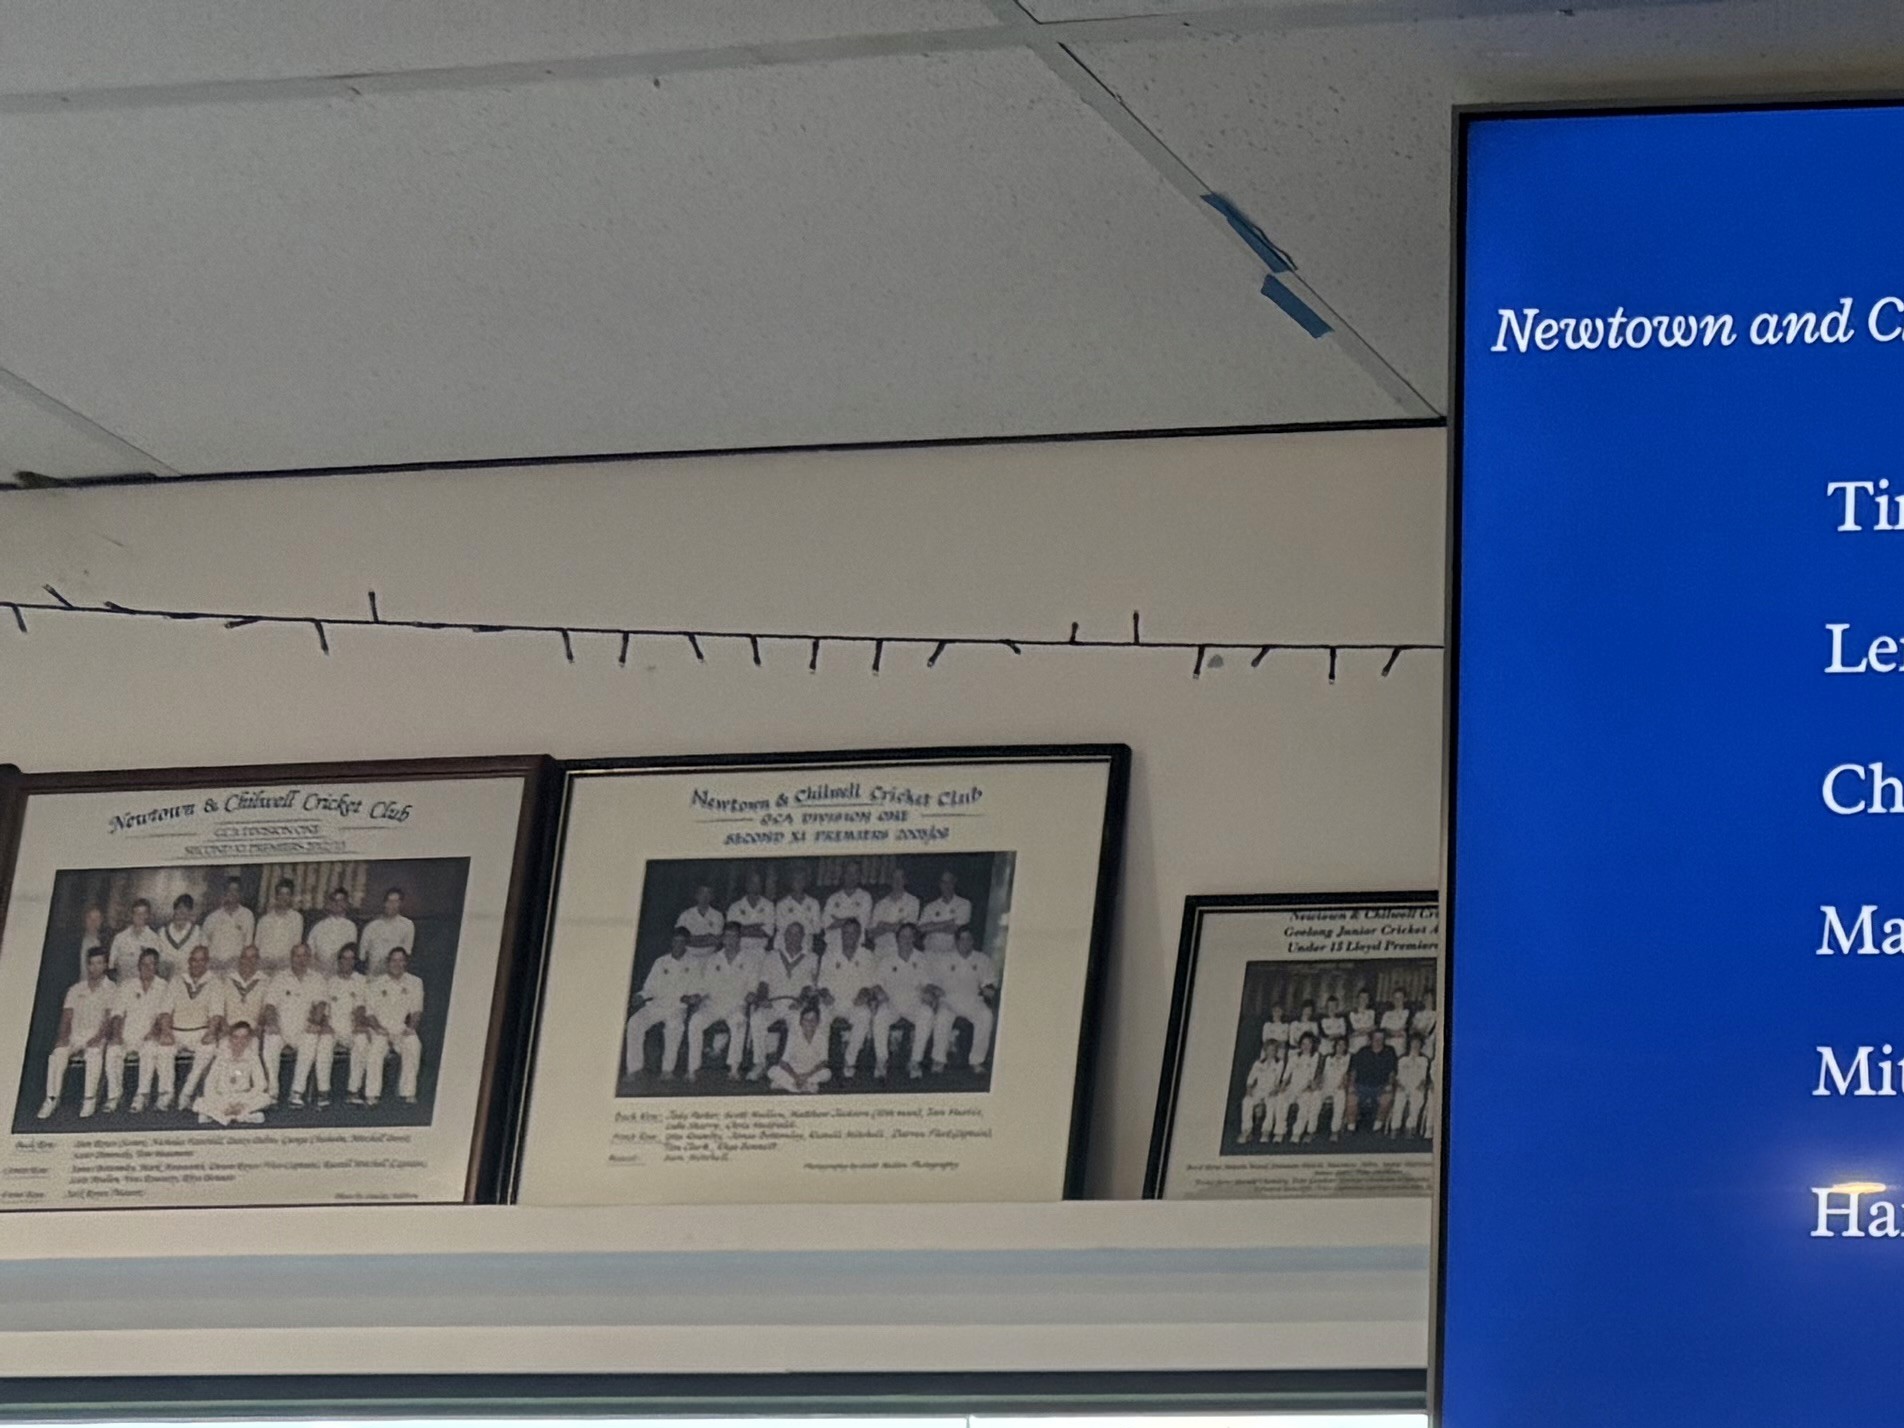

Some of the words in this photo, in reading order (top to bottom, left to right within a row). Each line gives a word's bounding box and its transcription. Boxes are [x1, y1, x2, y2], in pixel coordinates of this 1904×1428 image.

[1490, 306, 1737, 353] Newtown
[1749, 297, 1855, 345] and
[109, 803, 195, 834] Newtown
[203, 798, 219, 813] &
[224, 790, 300, 812] Chilwell
[303, 793, 362, 817] Cricket
[369, 801, 413, 823] Club
[690, 786, 770, 813] Newtown
[774, 793, 788, 807] &
[794, 783, 861, 803] Chilwell
[868, 785, 930, 808] Cricket
[936, 786, 983, 807] Club
